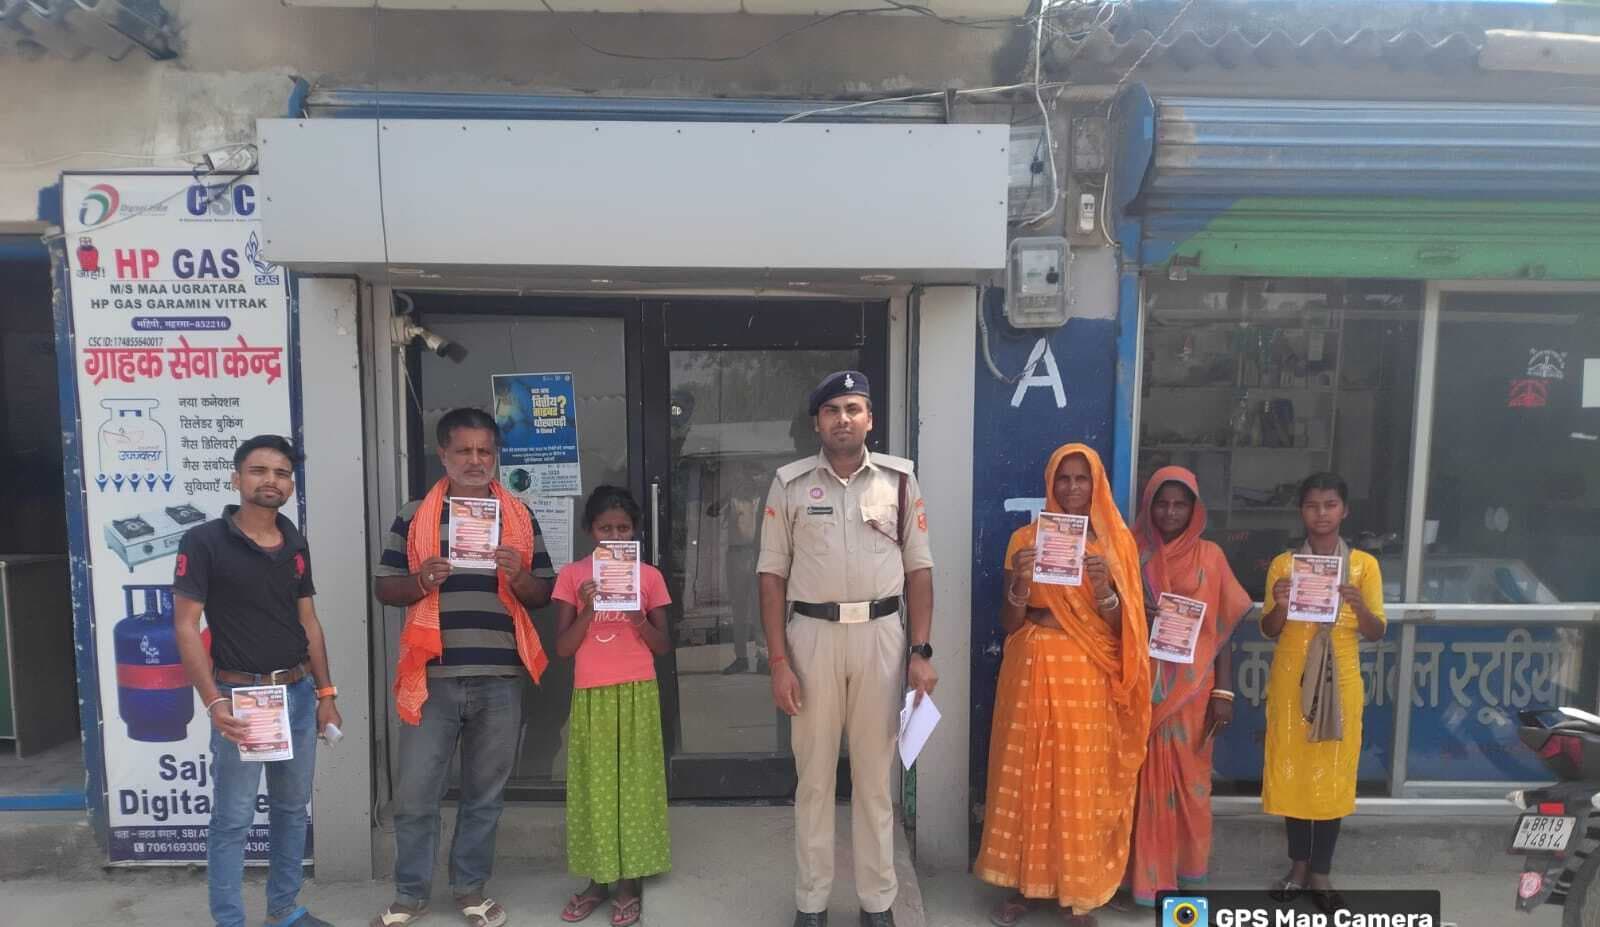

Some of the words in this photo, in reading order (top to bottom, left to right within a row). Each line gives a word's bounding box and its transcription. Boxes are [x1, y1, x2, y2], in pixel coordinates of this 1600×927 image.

[187, 184, 255, 215] CSC
[115, 249, 160, 279] HP
[172, 249, 240, 279] GAS
[255, 275, 279, 285] GAS
[110, 284, 133, 294] M/S
[138, 284, 168, 294] MAA
[172, 283, 246, 294] UGRATARA
[91, 299, 109, 310] HP
[114, 299, 142, 309] GAS
[147, 299, 211, 309] GARAMIN
[216, 298, 268, 309] VITRAK
[88, 337, 102, 347] CSC
[83, 348, 164, 386] ग्राहक
[167, 335, 219, 380] सेवा
[221, 335, 283, 386] केन्द्र
[1010, 337, 1067, 408] A
[178, 397, 198, 408] नया
[200, 394, 240, 408] कनेक्शन
[216, 414, 243, 433] बुकिंग
[180, 437, 198, 449] गैस
[182, 457, 200, 471] गैस
[176, 553, 188, 577] 3
[120, 789, 210, 822] Digita
[1531, 818, 1564, 832] BR19
[181, 829, 197, 838] SBI
[198, 828, 208, 838] AT
[147, 842, 207, 852] 706169306
